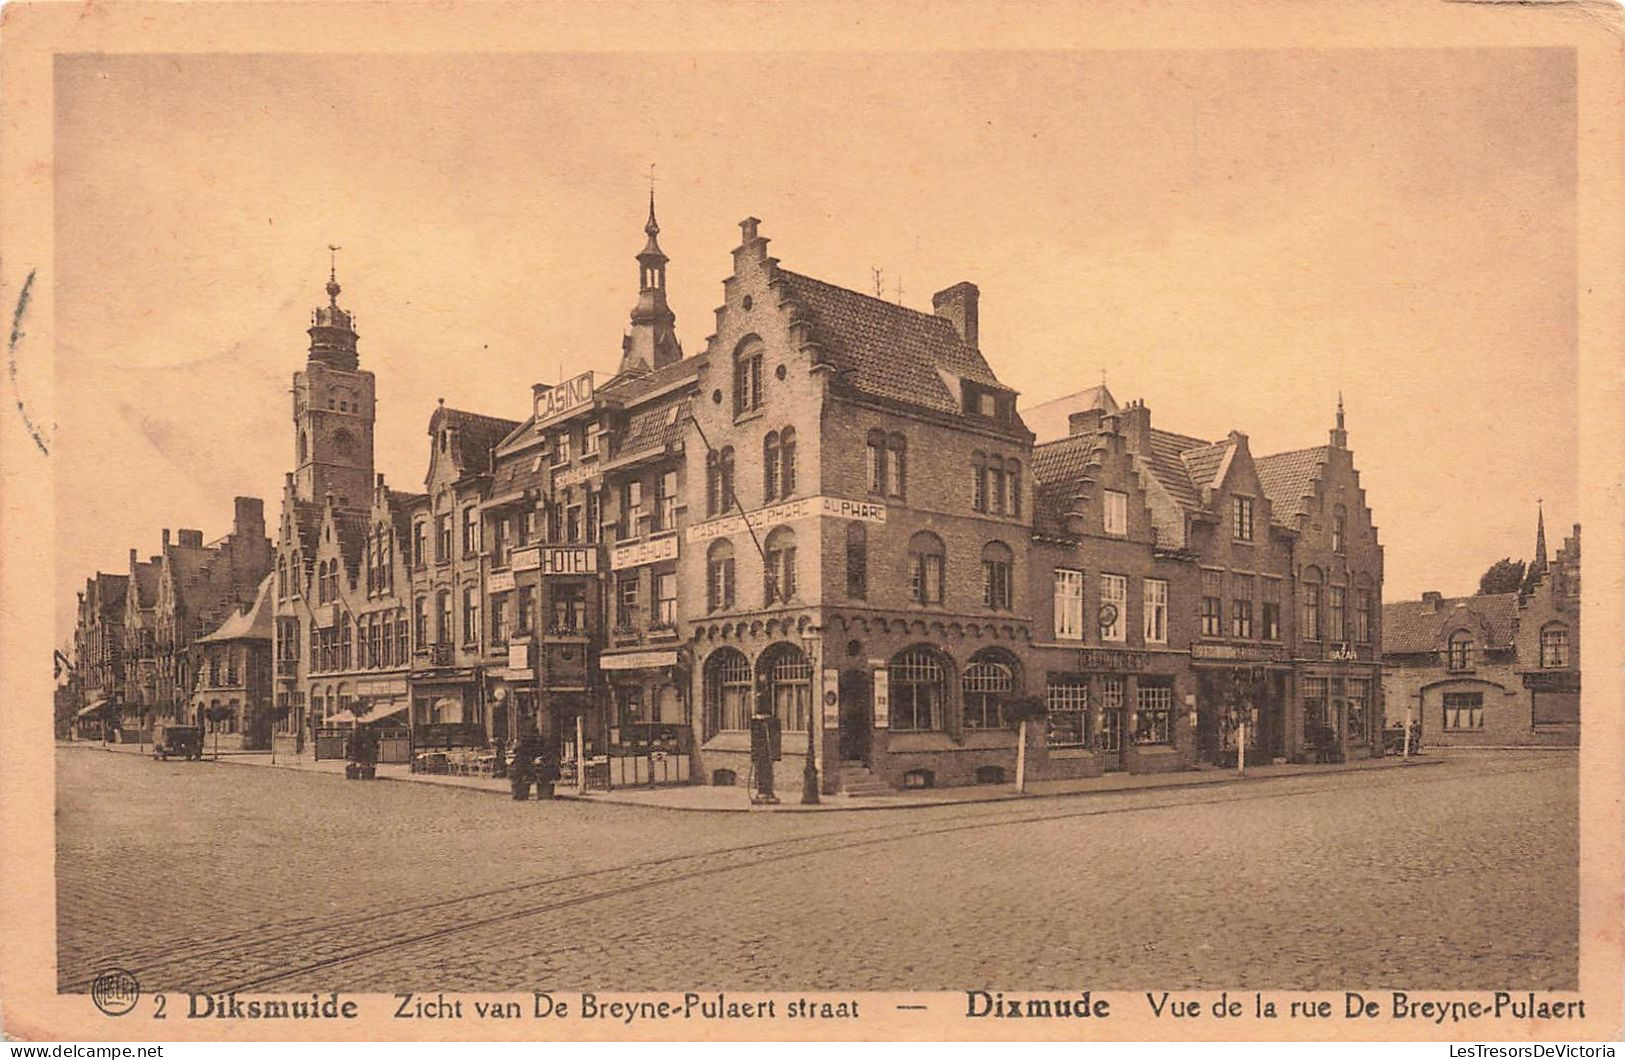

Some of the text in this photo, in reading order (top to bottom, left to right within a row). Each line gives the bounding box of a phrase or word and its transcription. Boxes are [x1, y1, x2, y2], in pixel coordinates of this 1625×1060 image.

[536, 374, 593, 420] CASINO
[823, 498, 885, 521] AU PHARE
[543, 548, 597, 574] HOTEL
